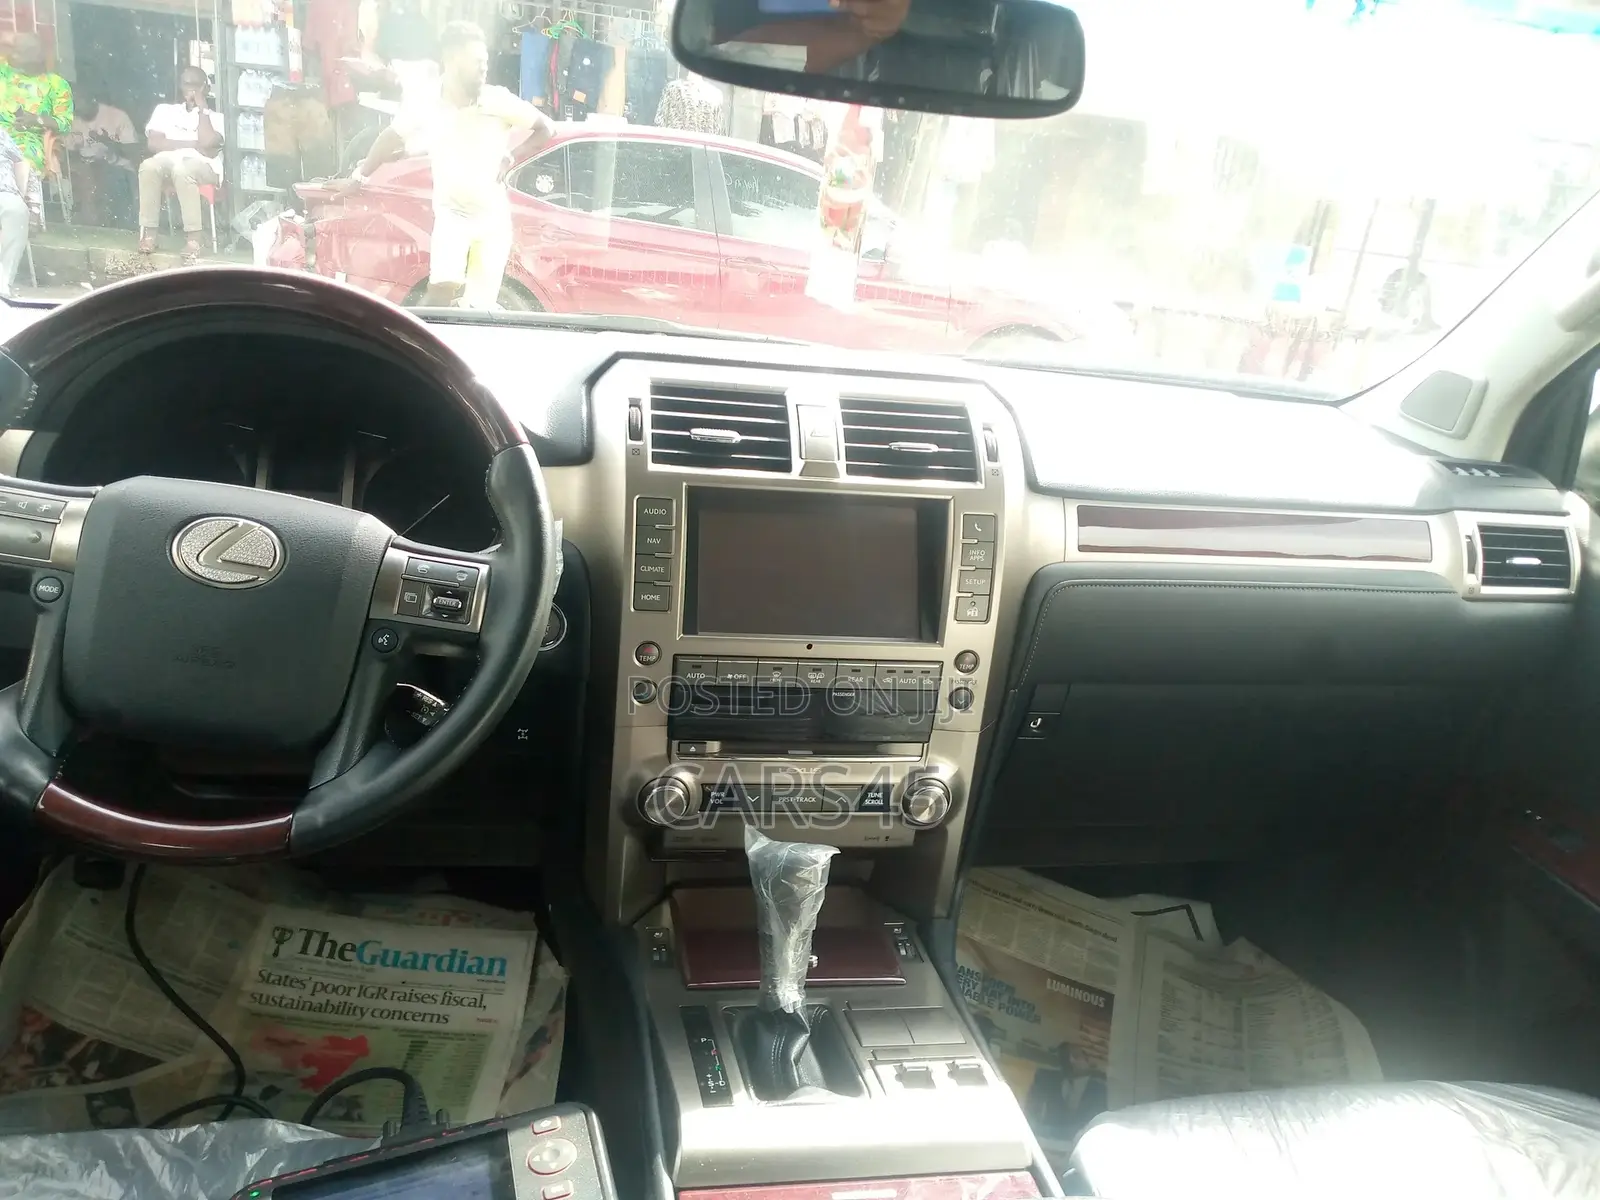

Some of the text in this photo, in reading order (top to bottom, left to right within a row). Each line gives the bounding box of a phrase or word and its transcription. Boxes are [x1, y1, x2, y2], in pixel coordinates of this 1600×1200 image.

[643, 508, 667, 516] AUDIO
[640, 565, 665, 573] CLIMATE
[38, 584, 60, 594] MODE
[437, 598, 457, 607] ENTER
[639, 654, 656, 662] TEMP
[958, 662, 975, 670] TEMP
[778, 766, 823, 774] LEXUS
[310, 980, 356, 997] poor
[357, 984, 388, 1000] IGR
[390, 988, 440, 1005] raises
[440, 990, 487, 1011] fiscal,
[1046, 978, 1107, 1008] LUMINOUS
[249, 992, 370, 1021] sustainability
[370, 1006, 451, 1025] concerns
